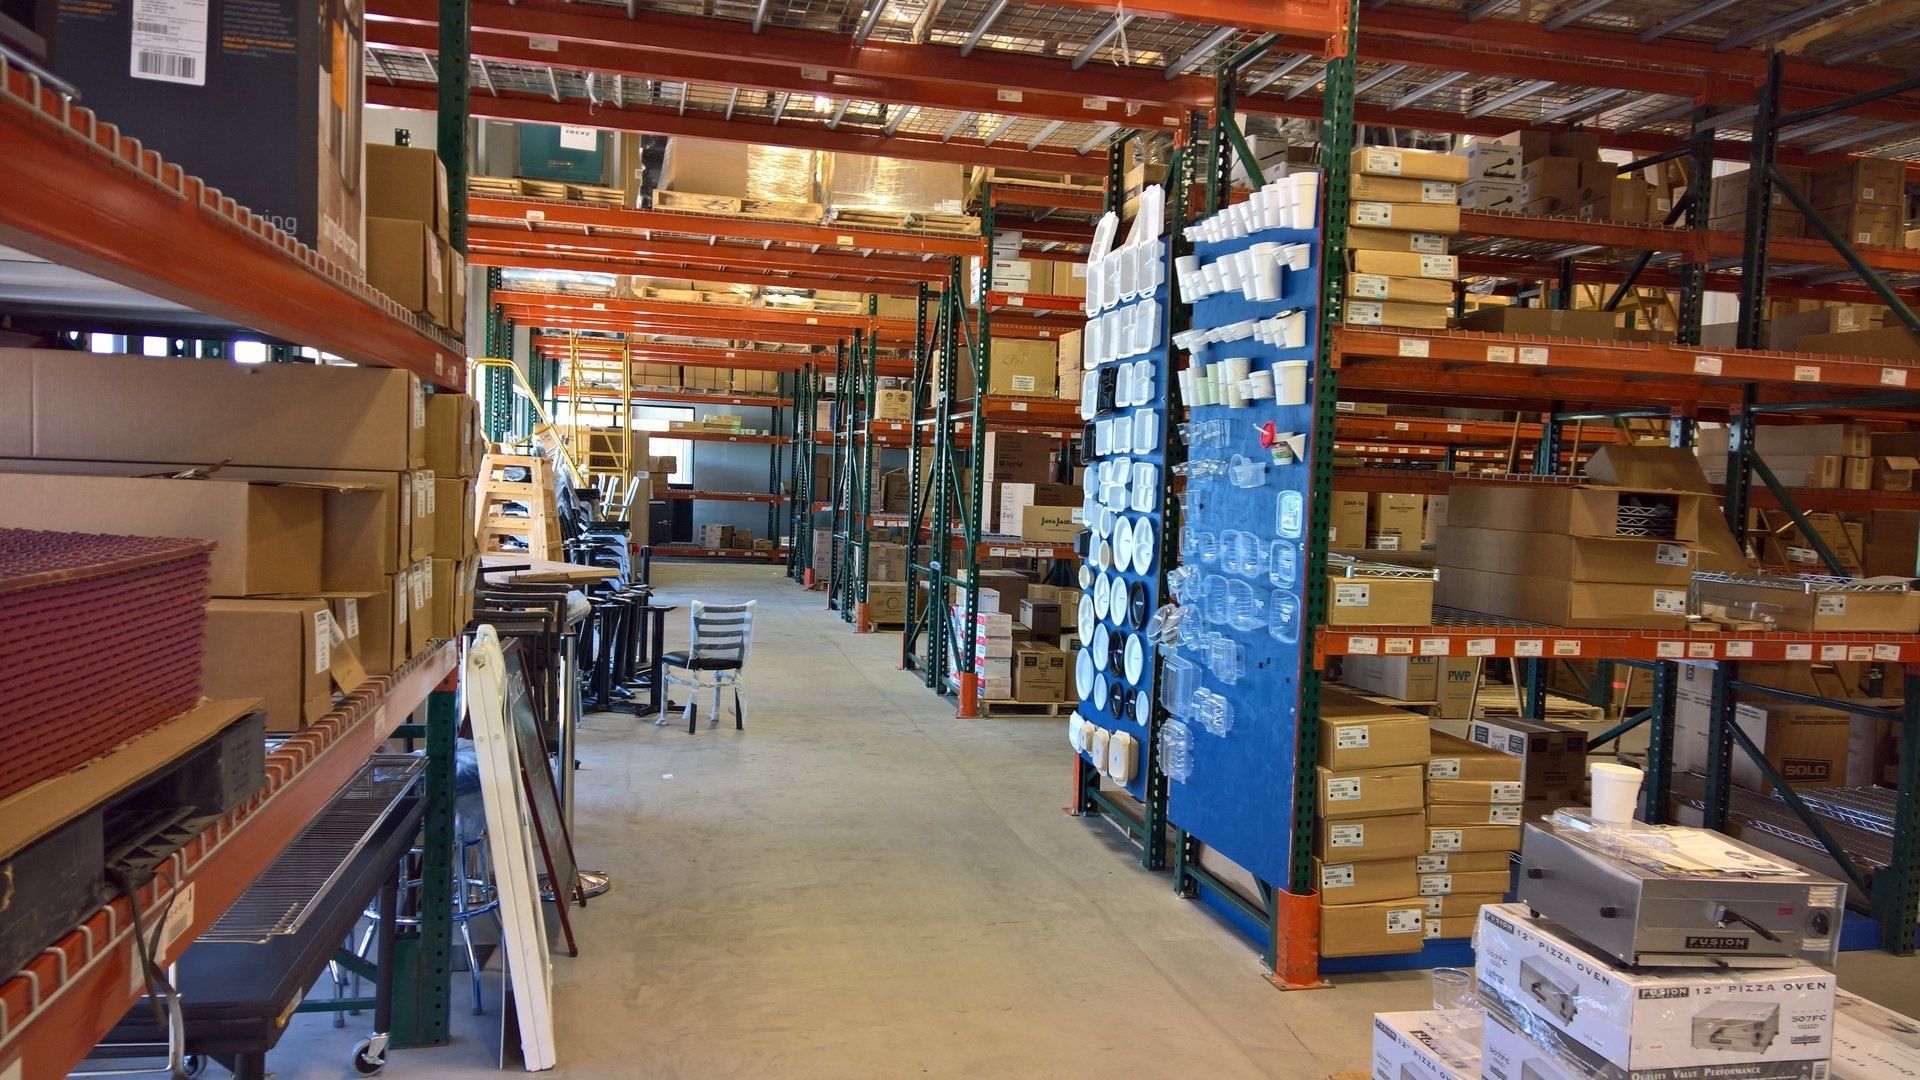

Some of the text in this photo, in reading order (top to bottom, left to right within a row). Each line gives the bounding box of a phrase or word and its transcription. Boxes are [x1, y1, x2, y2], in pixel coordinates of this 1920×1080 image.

[1448, 670, 1471, 682] PWP
[1785, 765, 1826, 776] SOLO
[1689, 937, 1745, 946] FUSION
[1486, 912, 1514, 932] FUSION
[1539, 941, 1572, 965] PIZZA
[1577, 963, 1610, 986] OVEN
[1641, 988, 1688, 997] FUSION
[1728, 984, 1775, 993] PIZZA
[1783, 982, 1827, 991] OVEN
[1413, 1050, 1437, 1072] PIZZA
[1673, 1070, 1698, 1079] VALUE
[1704, 1067, 1761, 1077] PERFORMANCE
